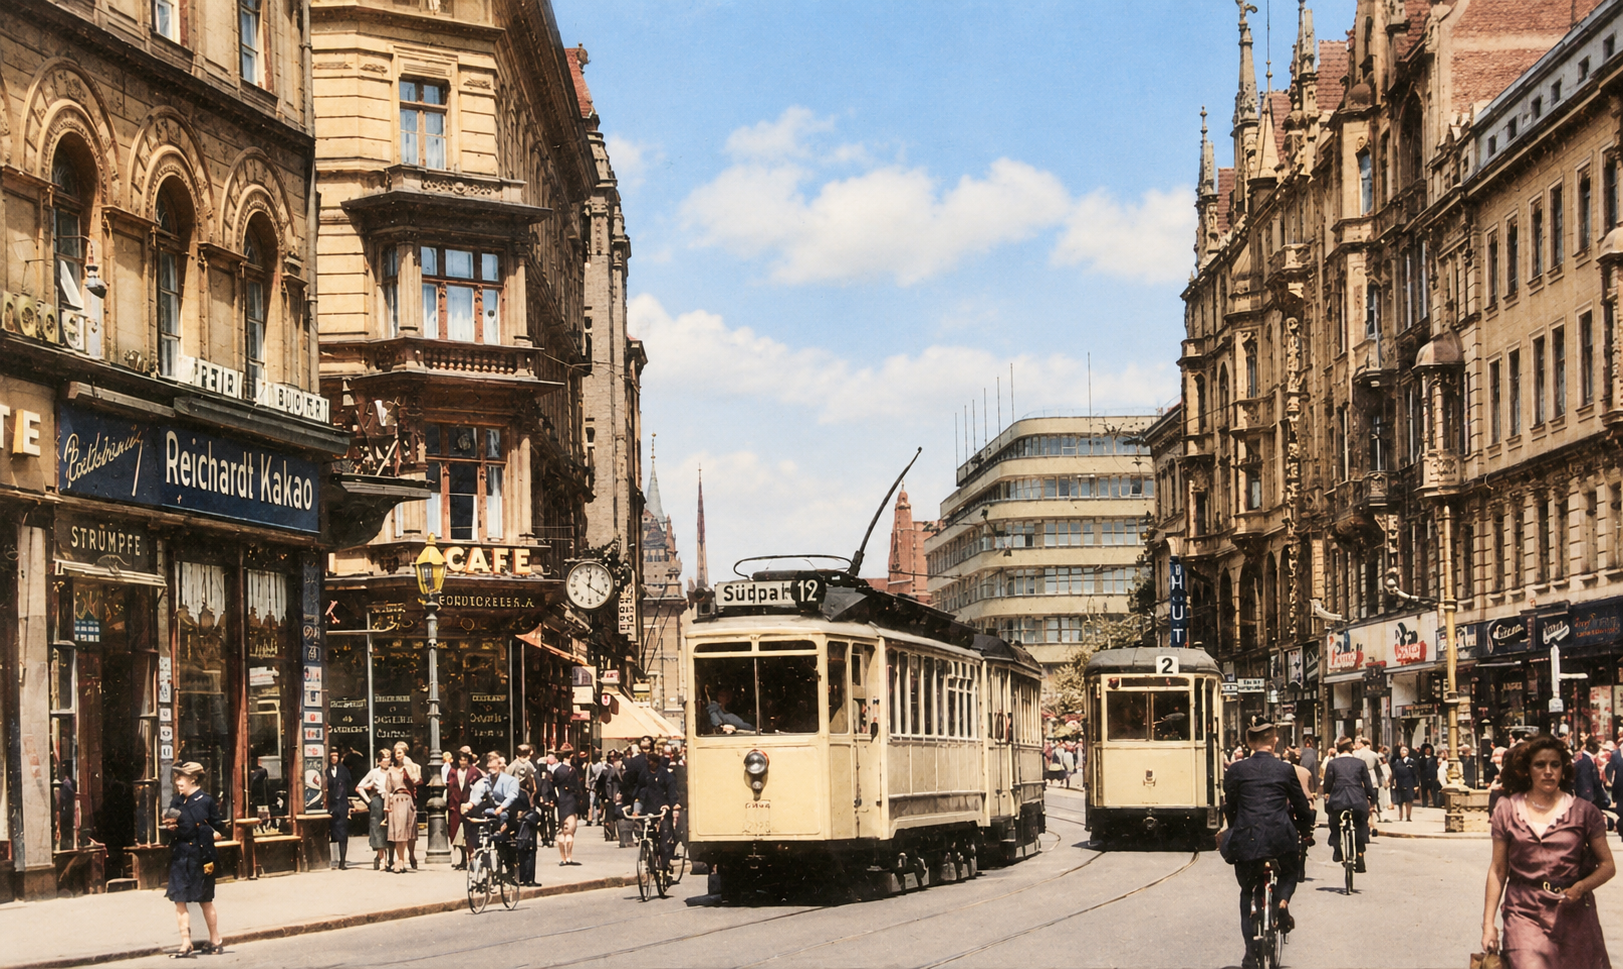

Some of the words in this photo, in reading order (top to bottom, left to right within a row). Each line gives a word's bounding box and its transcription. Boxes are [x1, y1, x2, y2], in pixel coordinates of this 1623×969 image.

[165, 430, 254, 500] Reichardt
[260, 453, 313, 511] Kakao
[443, 546, 532, 575] CAFE
[797, 579, 818, 602] 12
[1161, 657, 1174, 674] 2
